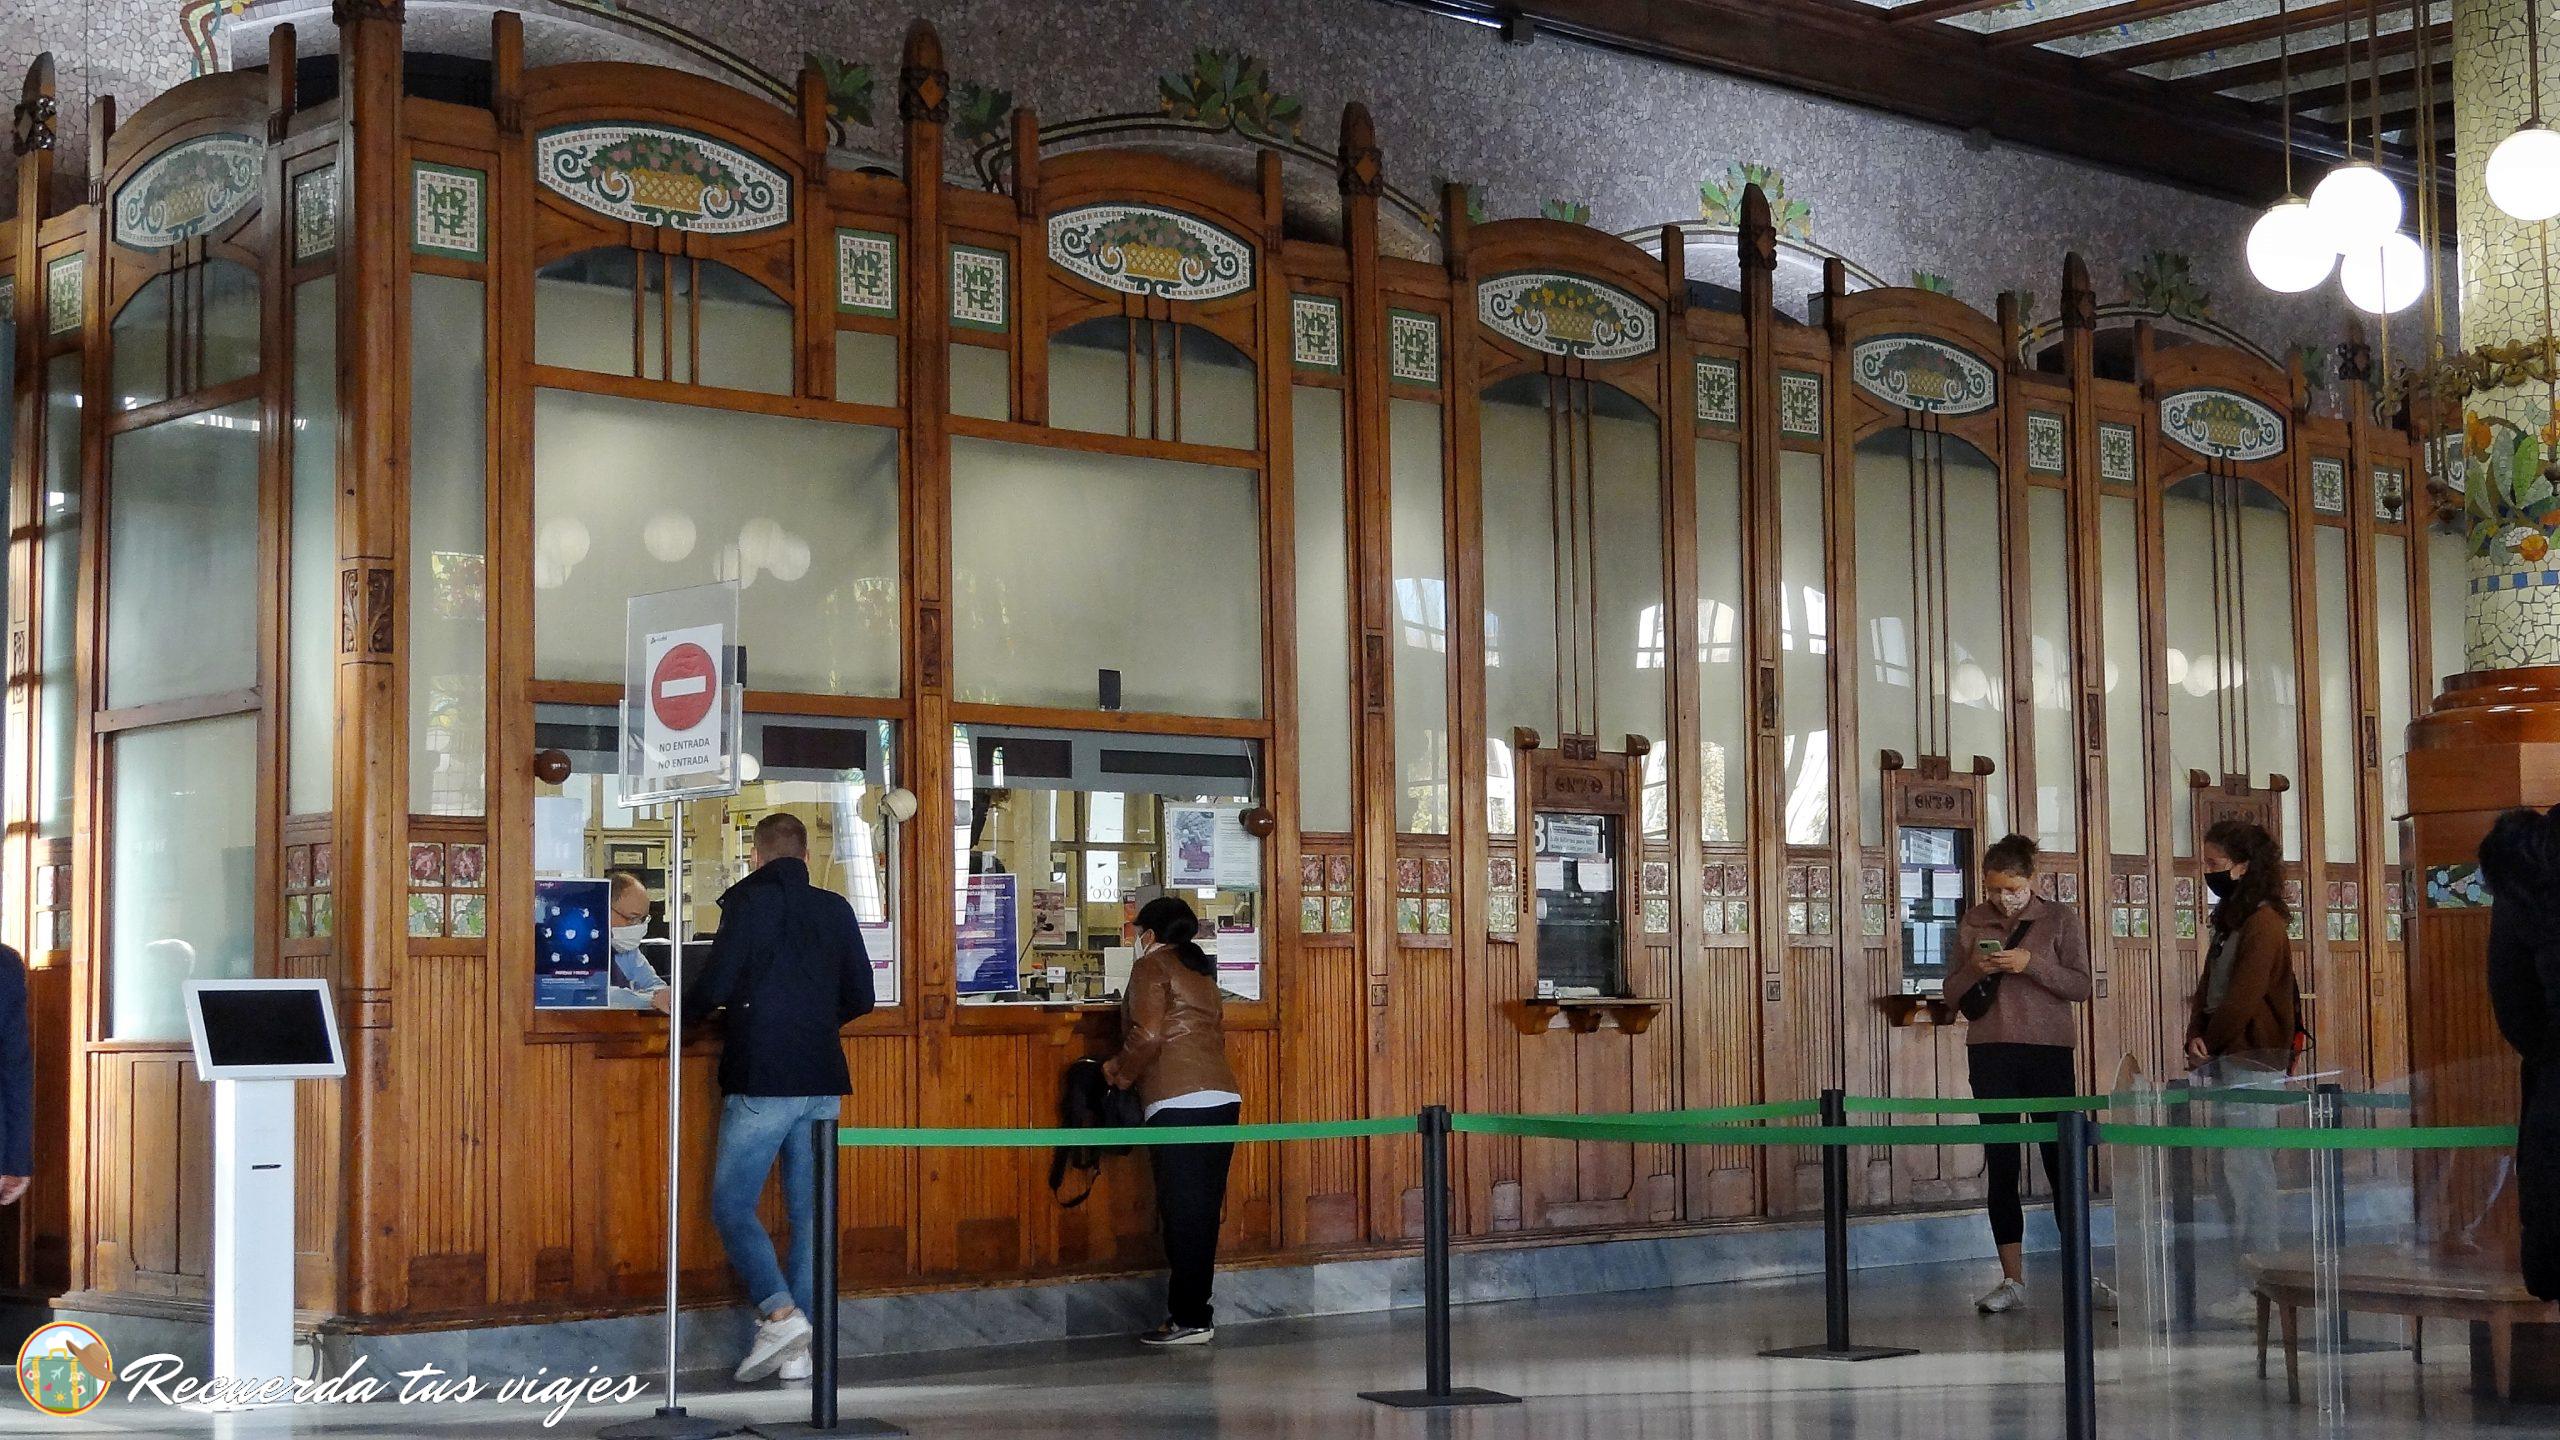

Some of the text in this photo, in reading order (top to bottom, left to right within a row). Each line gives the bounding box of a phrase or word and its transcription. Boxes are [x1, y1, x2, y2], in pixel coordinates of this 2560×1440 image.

[659, 738, 710, 753] NO ENTRADA
[658, 755, 709, 770] NO ENTRADA
